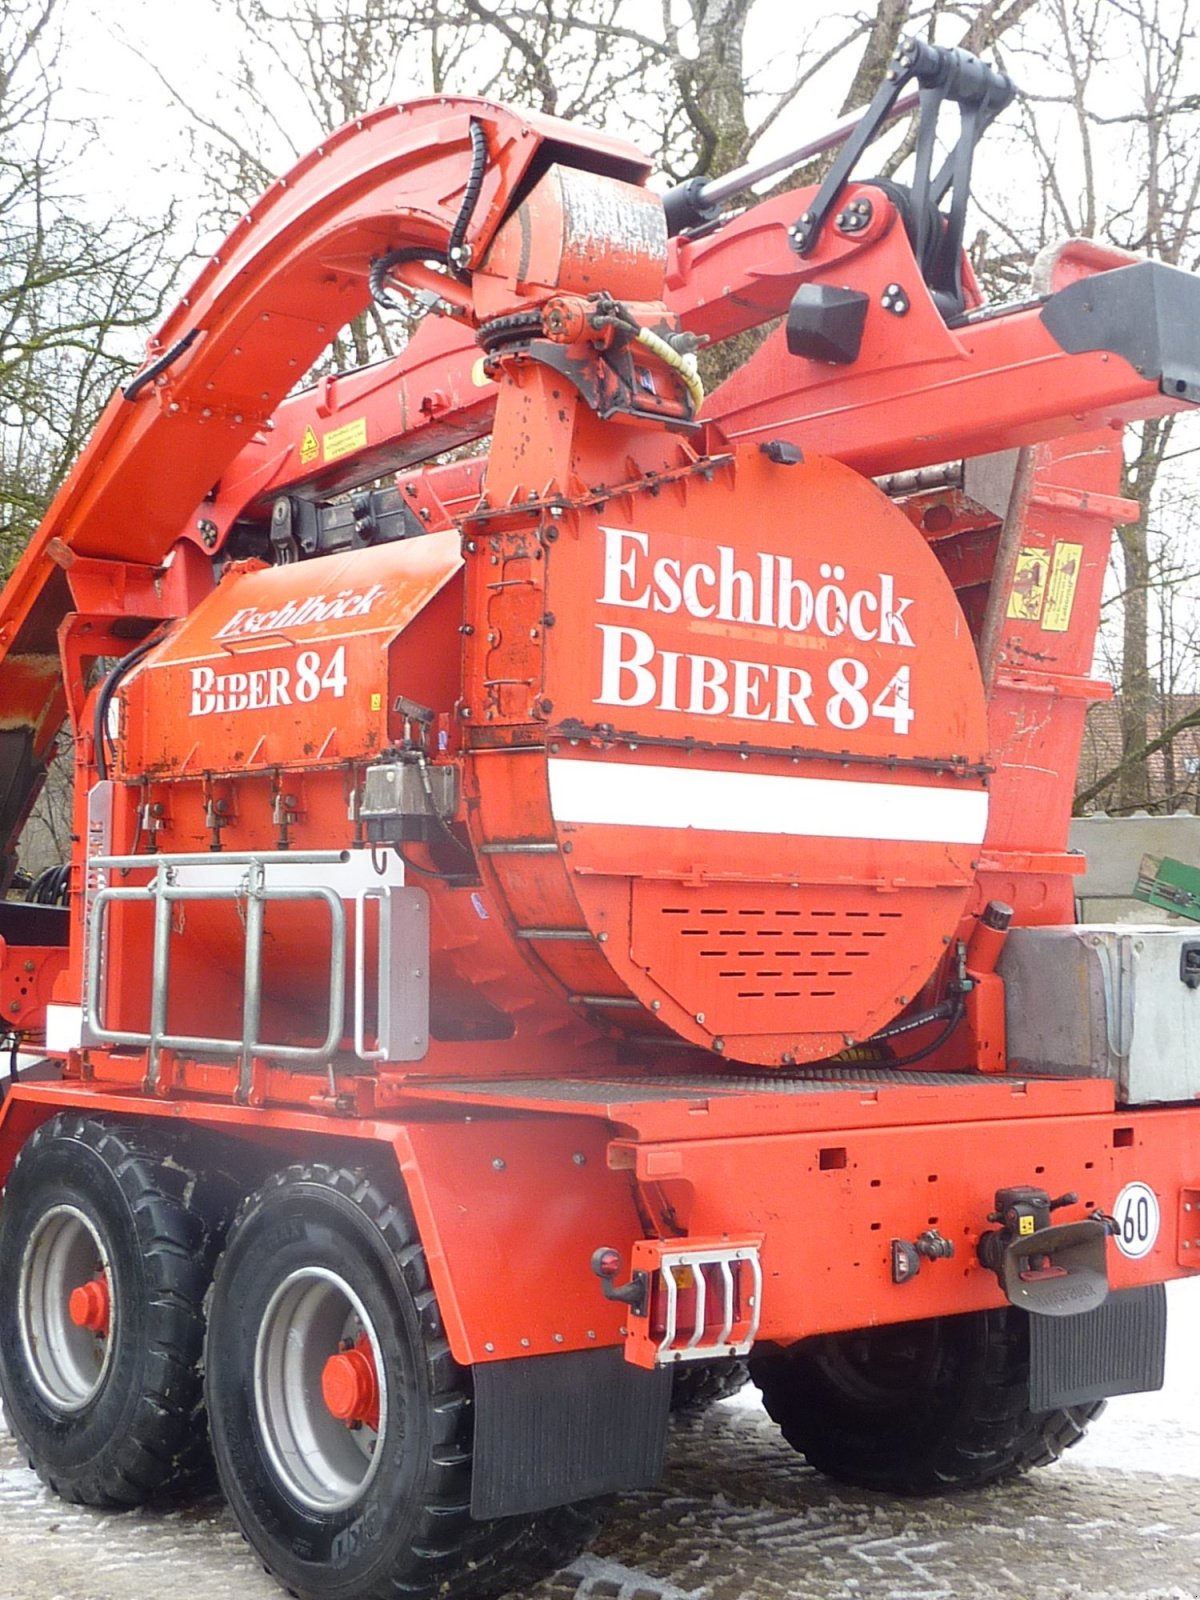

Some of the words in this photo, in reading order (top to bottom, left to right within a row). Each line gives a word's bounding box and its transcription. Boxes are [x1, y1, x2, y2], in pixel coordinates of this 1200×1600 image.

[211, 584, 387, 640] Eschlböck
[595, 526, 916, 648] Eschlböck
[188, 666, 293, 717] BIBER
[295, 645, 348, 703] 84
[592, 623, 819, 727] BIBER
[825, 657, 915, 735] 84
[1123, 1196, 1149, 1244] 60
